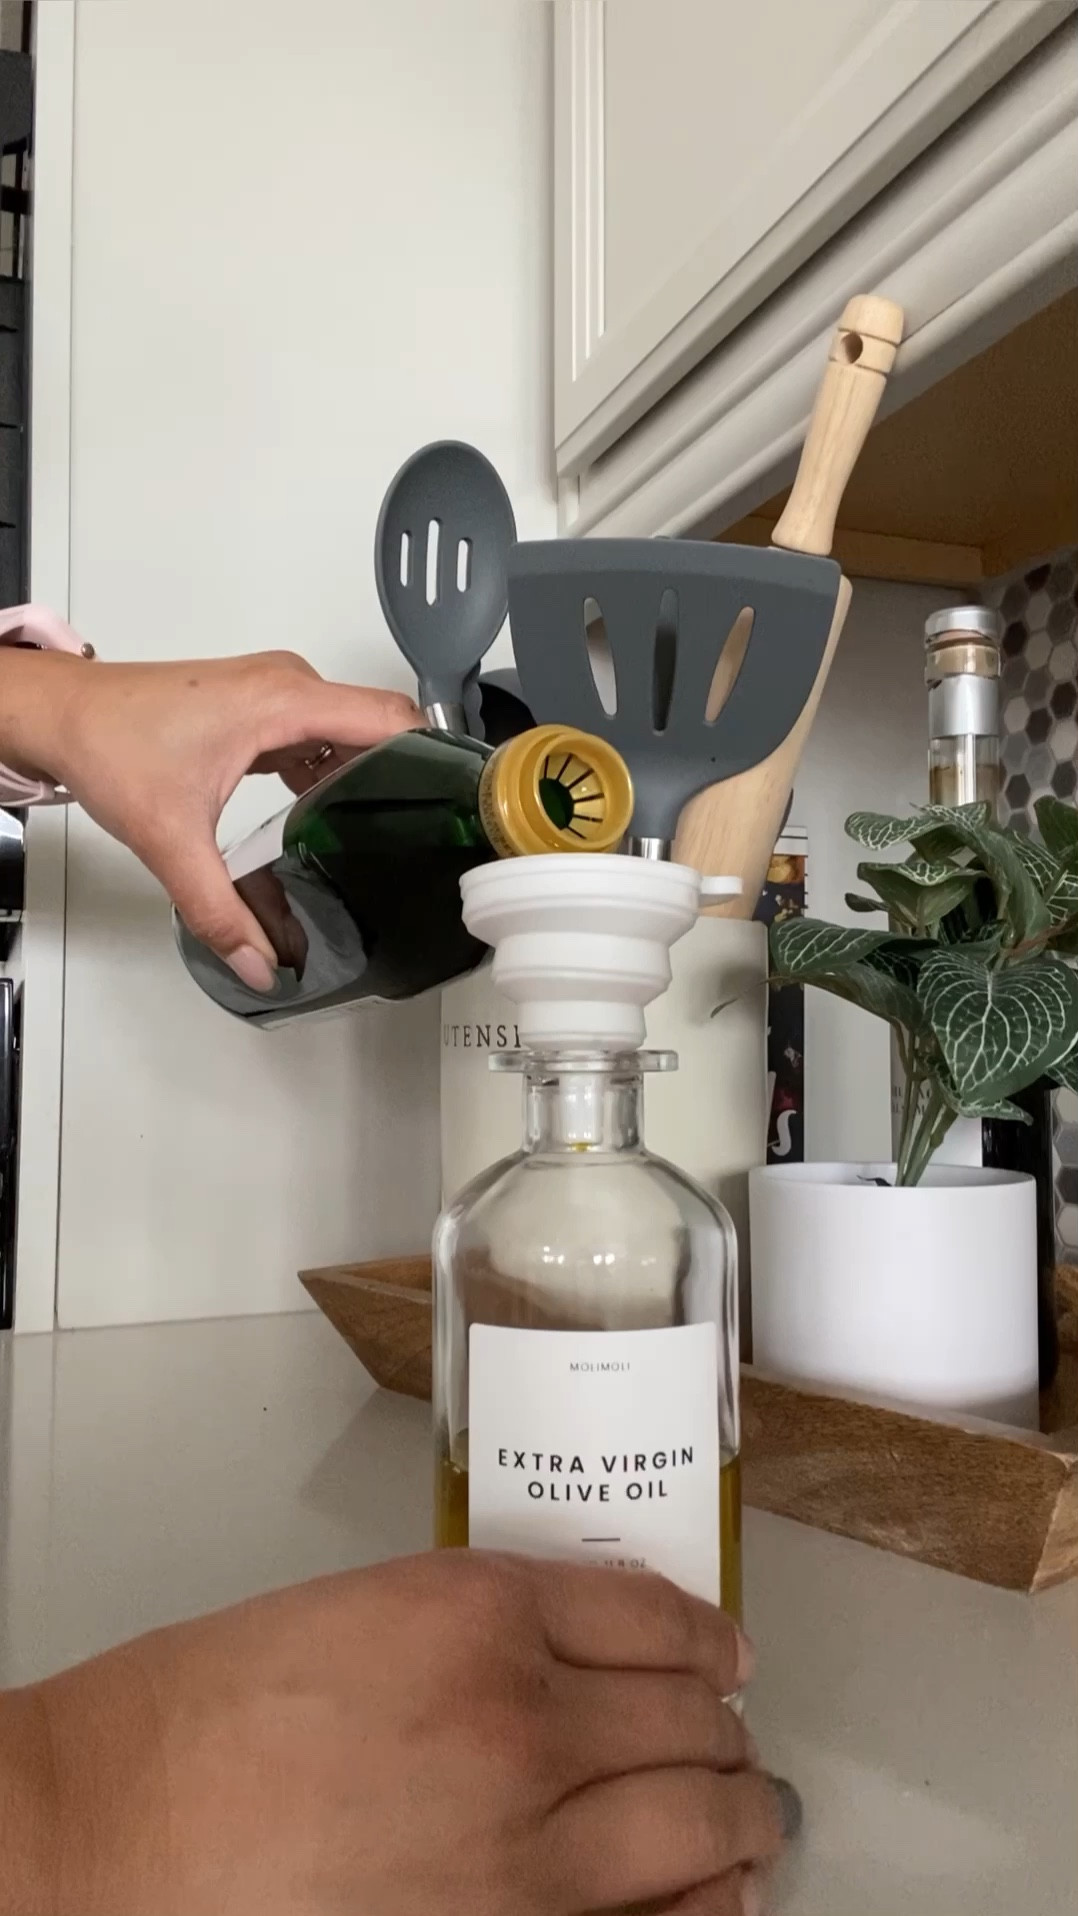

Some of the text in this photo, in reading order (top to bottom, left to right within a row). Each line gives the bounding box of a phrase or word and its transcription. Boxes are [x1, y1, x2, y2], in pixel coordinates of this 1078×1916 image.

[570, 1362, 630, 1372] MOLIMOLI
[498, 1446, 693, 1473] EXTRA VIRGIN
[528, 1480, 667, 1501] OLIVE OIL
